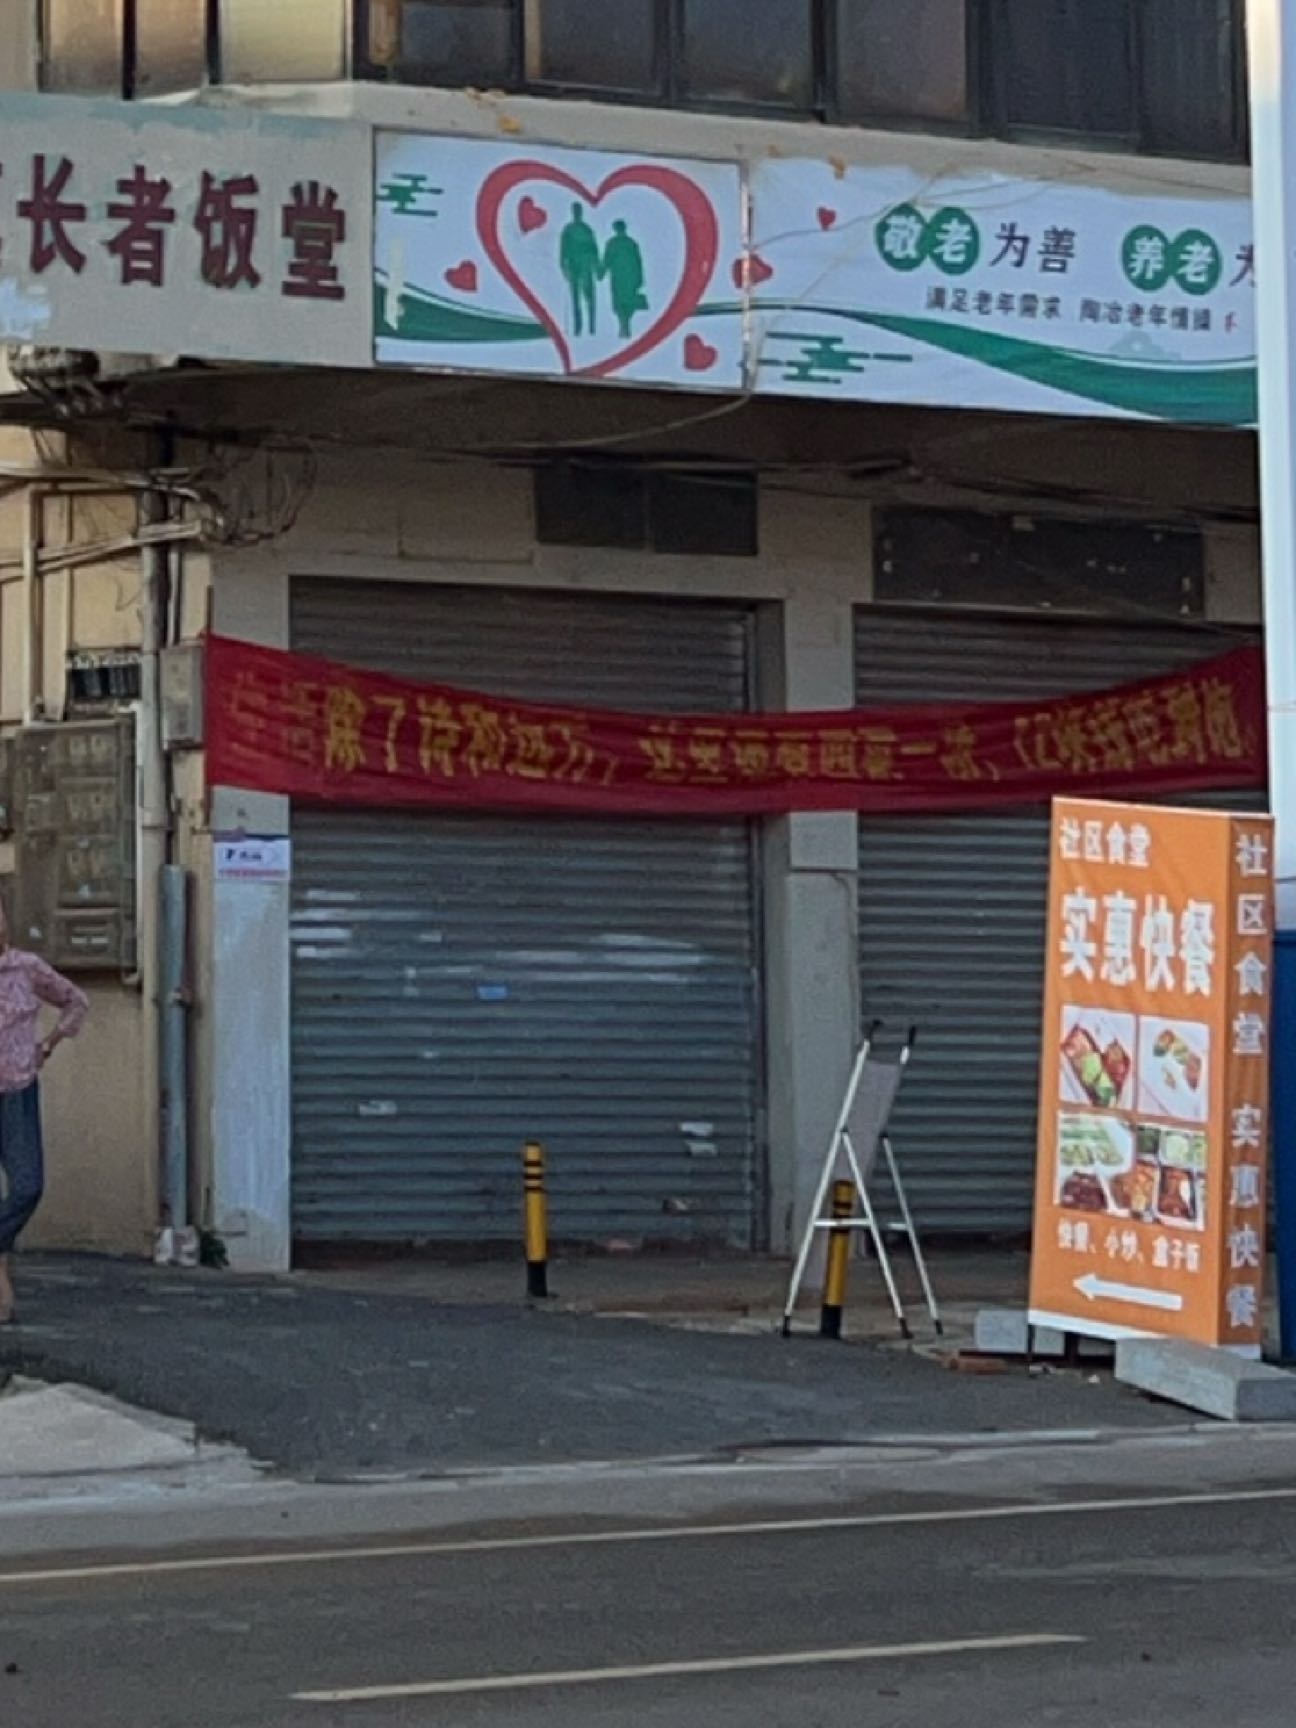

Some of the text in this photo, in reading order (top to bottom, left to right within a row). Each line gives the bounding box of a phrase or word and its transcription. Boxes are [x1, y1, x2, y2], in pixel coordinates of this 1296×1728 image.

[882, 215, 1076, 273] 敬老为善
[1059, 816, 1151, 867] 社区食堂
[1059, 885, 1216, 997] 实惠快餐
